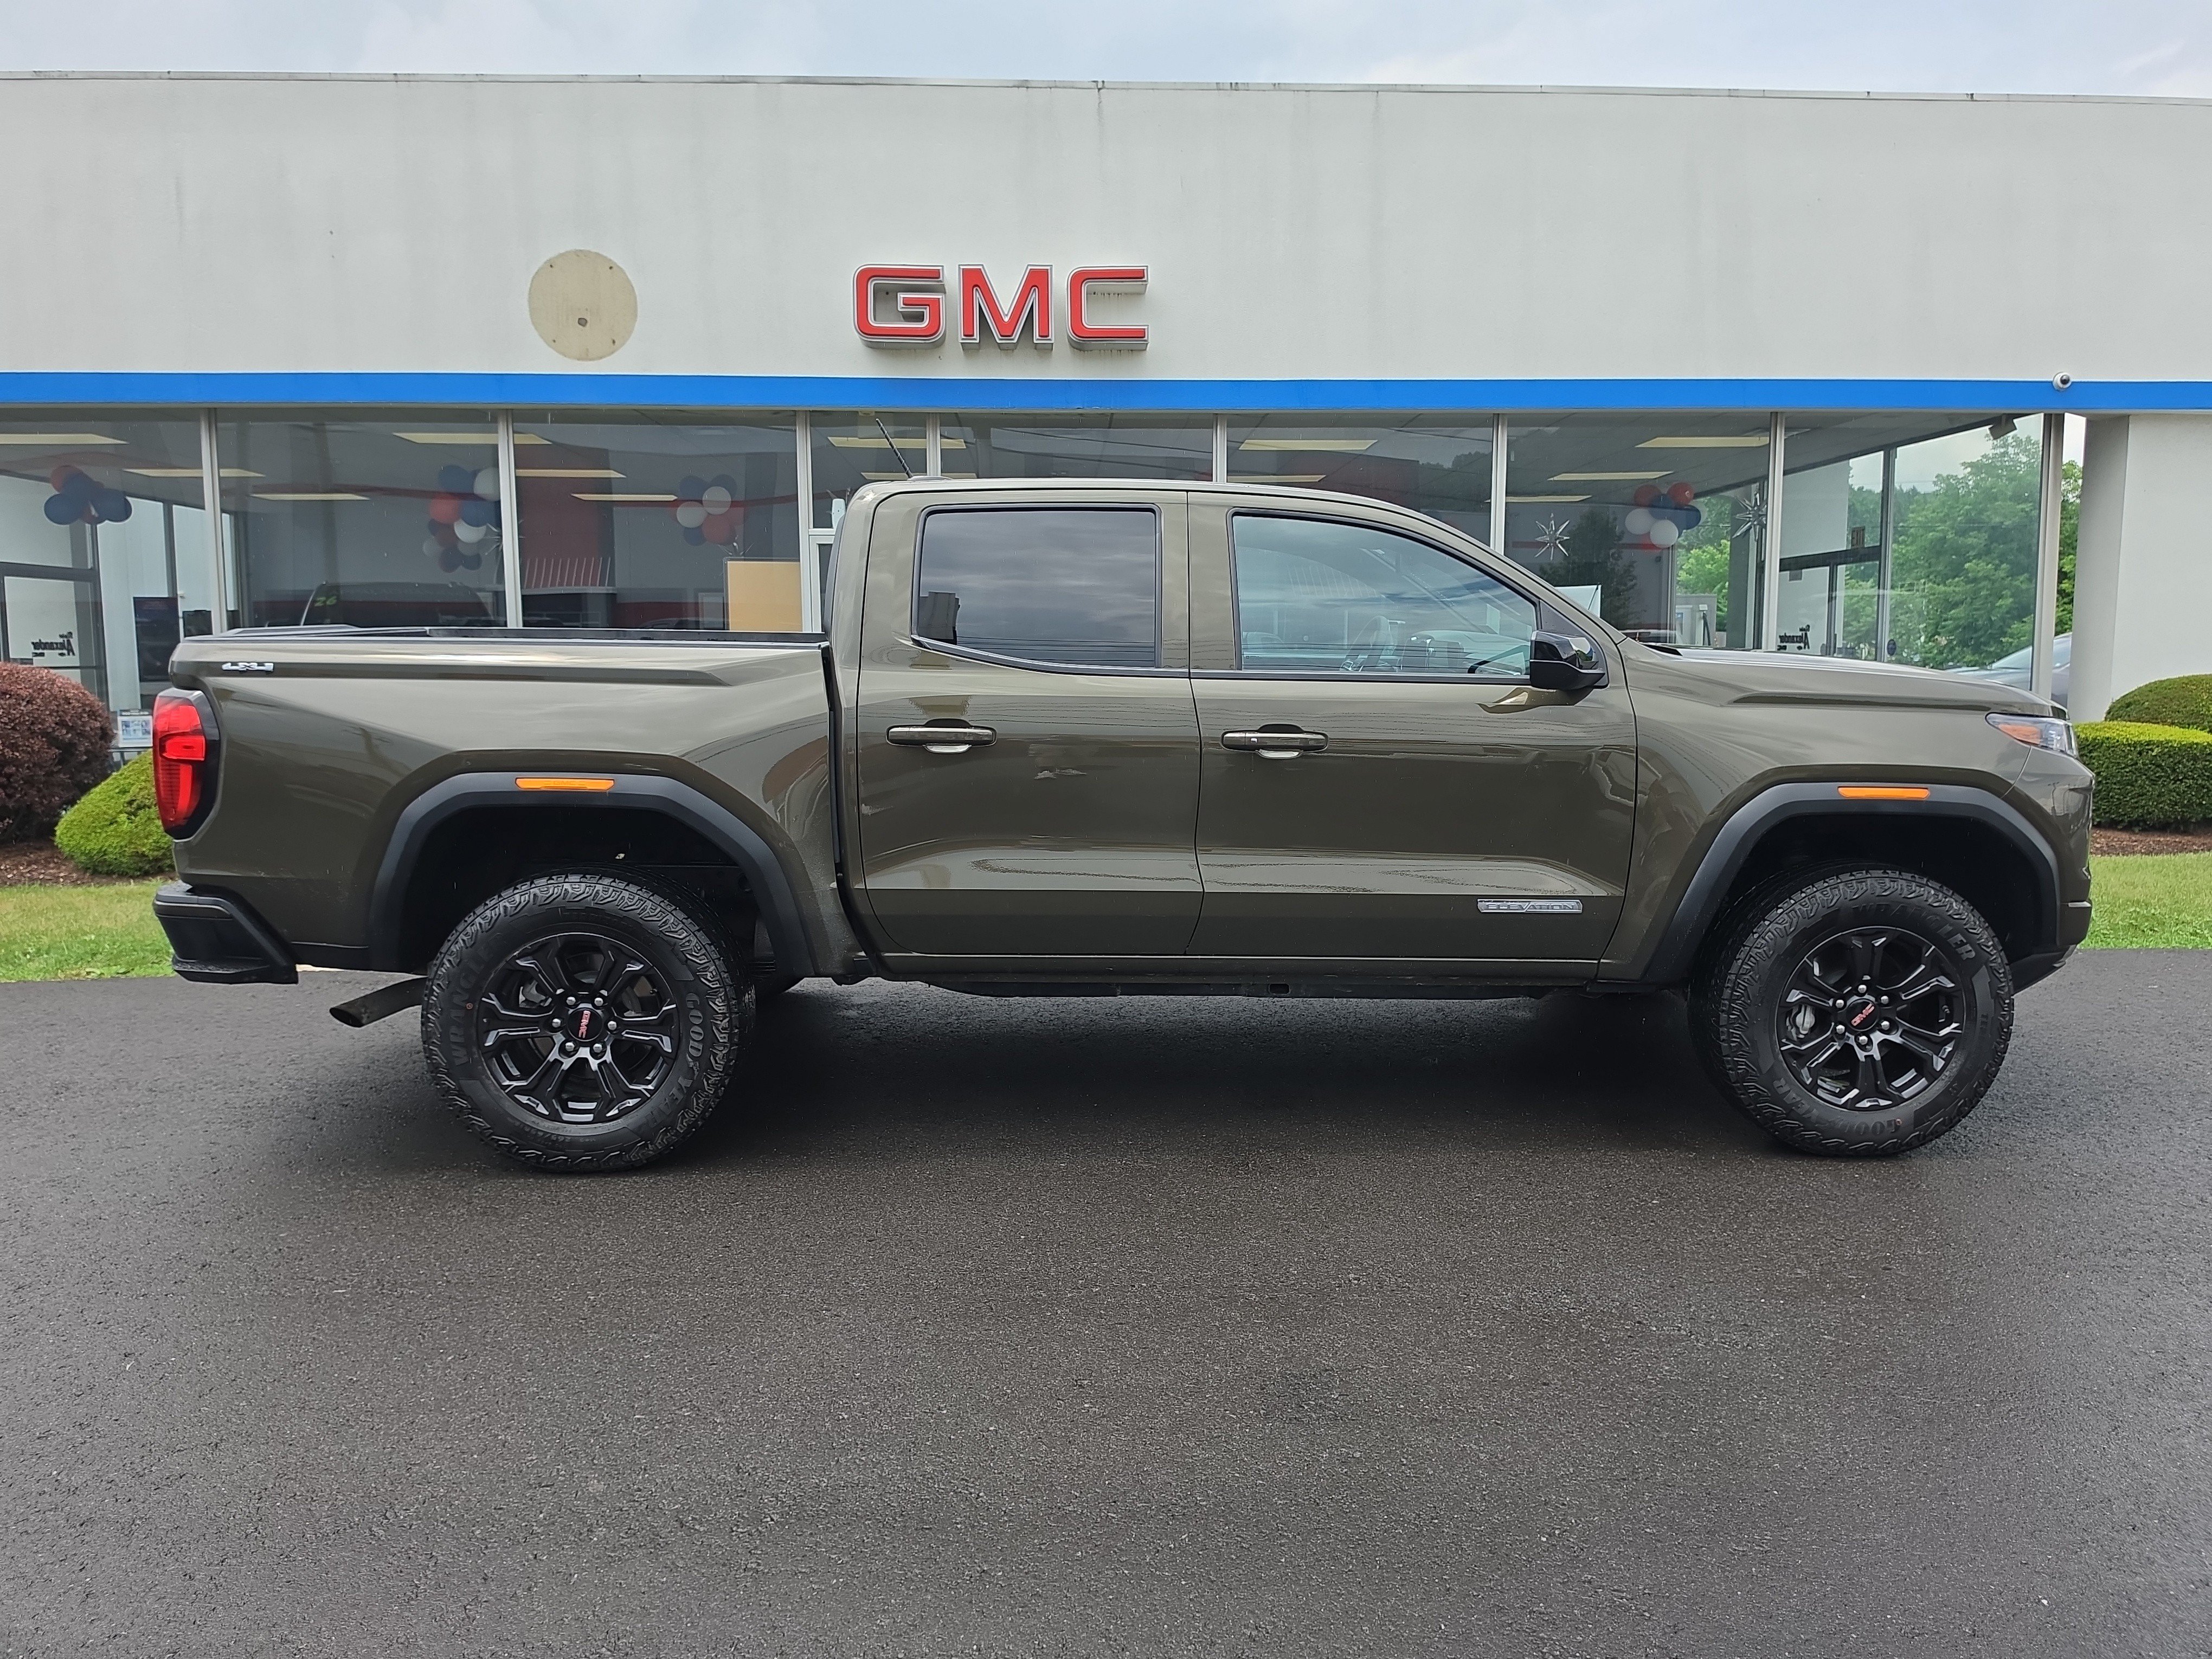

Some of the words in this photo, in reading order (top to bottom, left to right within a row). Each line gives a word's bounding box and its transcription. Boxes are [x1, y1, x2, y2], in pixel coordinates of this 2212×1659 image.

[853, 263, 1149, 347] GMC
[578, 1010, 591, 1038] GMC
[1851, 1002, 1875, 1026] GMC
